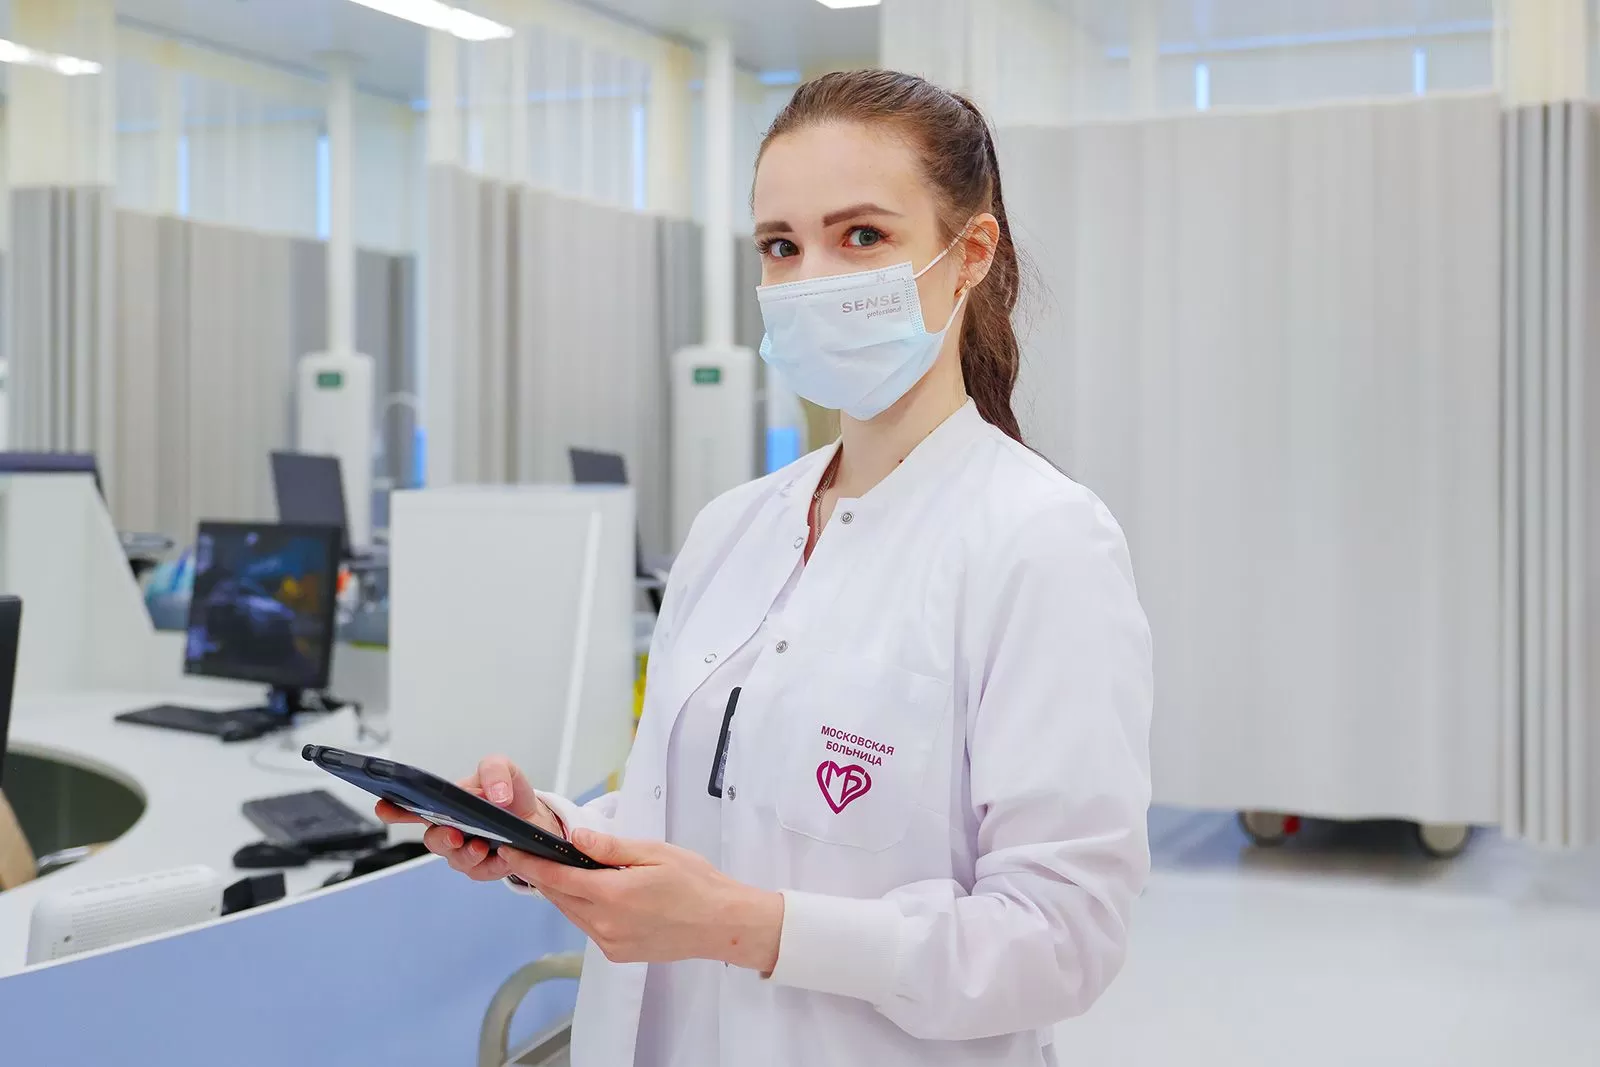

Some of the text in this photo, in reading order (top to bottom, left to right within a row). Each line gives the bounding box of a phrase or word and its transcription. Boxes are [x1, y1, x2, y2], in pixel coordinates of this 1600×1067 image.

[842, 292, 900, 313] SENSE
[821, 725, 895, 755] МОСКОВСКАЯ
[826, 740, 882, 766] БОЛЬНИЦА
